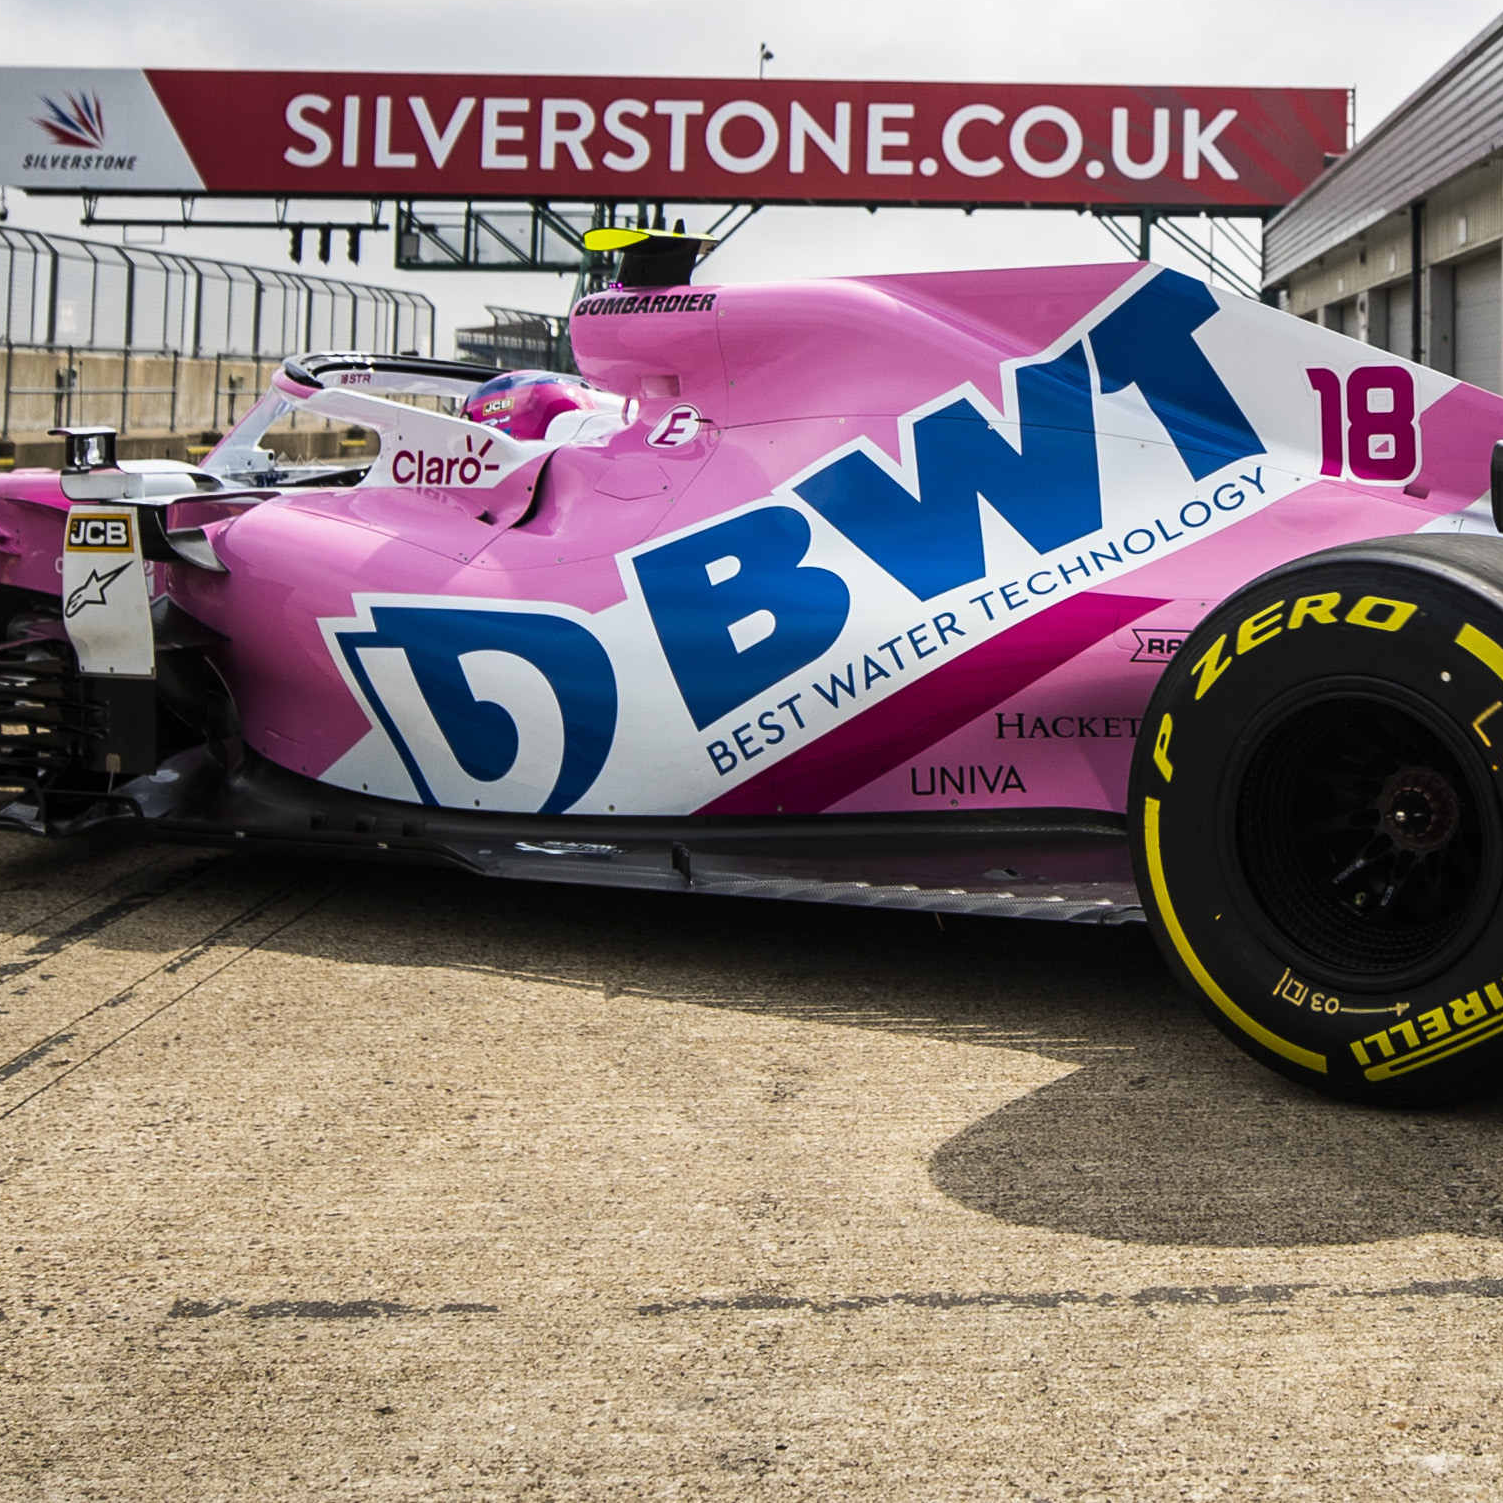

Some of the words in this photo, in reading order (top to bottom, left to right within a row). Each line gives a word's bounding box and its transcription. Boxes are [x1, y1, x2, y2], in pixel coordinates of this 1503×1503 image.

[283, 93, 1238, 181] SILVERSTONE.CO.UK
[22, 153, 137, 170] SILVERSTONE
[574, 293, 717, 316] BOMBARDIER
[349, 373, 371, 384] STR
[652, 412, 692, 445] E
[1305, 365, 1416, 481] 18
[392, 447, 482, 485] Claro
[631, 267, 1268, 732] BWT
[70, 520, 127, 545] JCB
[706, 694, 804, 777] BEST
[811, 611, 967, 709] WATER
[969, 466, 1268, 621] TECHNOLOGY
[1153, 713, 1173, 783] P
[1191, 591, 1418, 700] ZERO
[911, 765, 1027, 796] UNIVA
